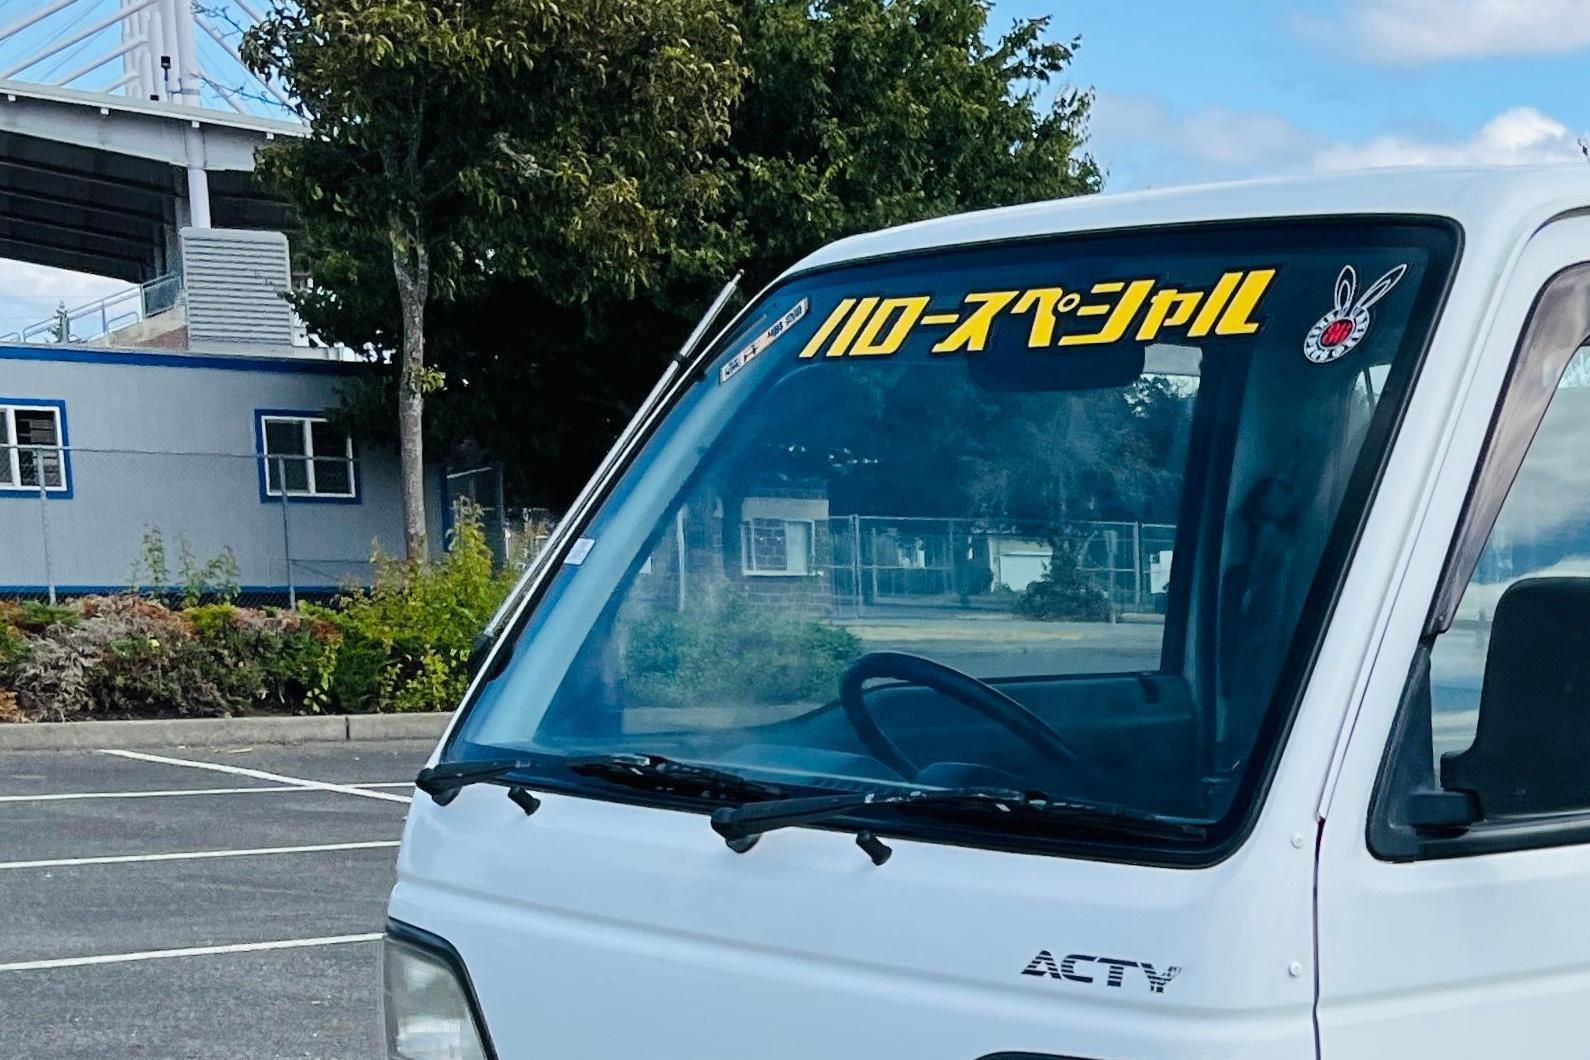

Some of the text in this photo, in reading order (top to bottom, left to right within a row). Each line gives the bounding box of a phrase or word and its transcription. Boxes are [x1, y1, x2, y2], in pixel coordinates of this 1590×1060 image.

[799, 269, 1276, 357] ハロースペシャル
[1020, 950, 1182, 993] ACTY
